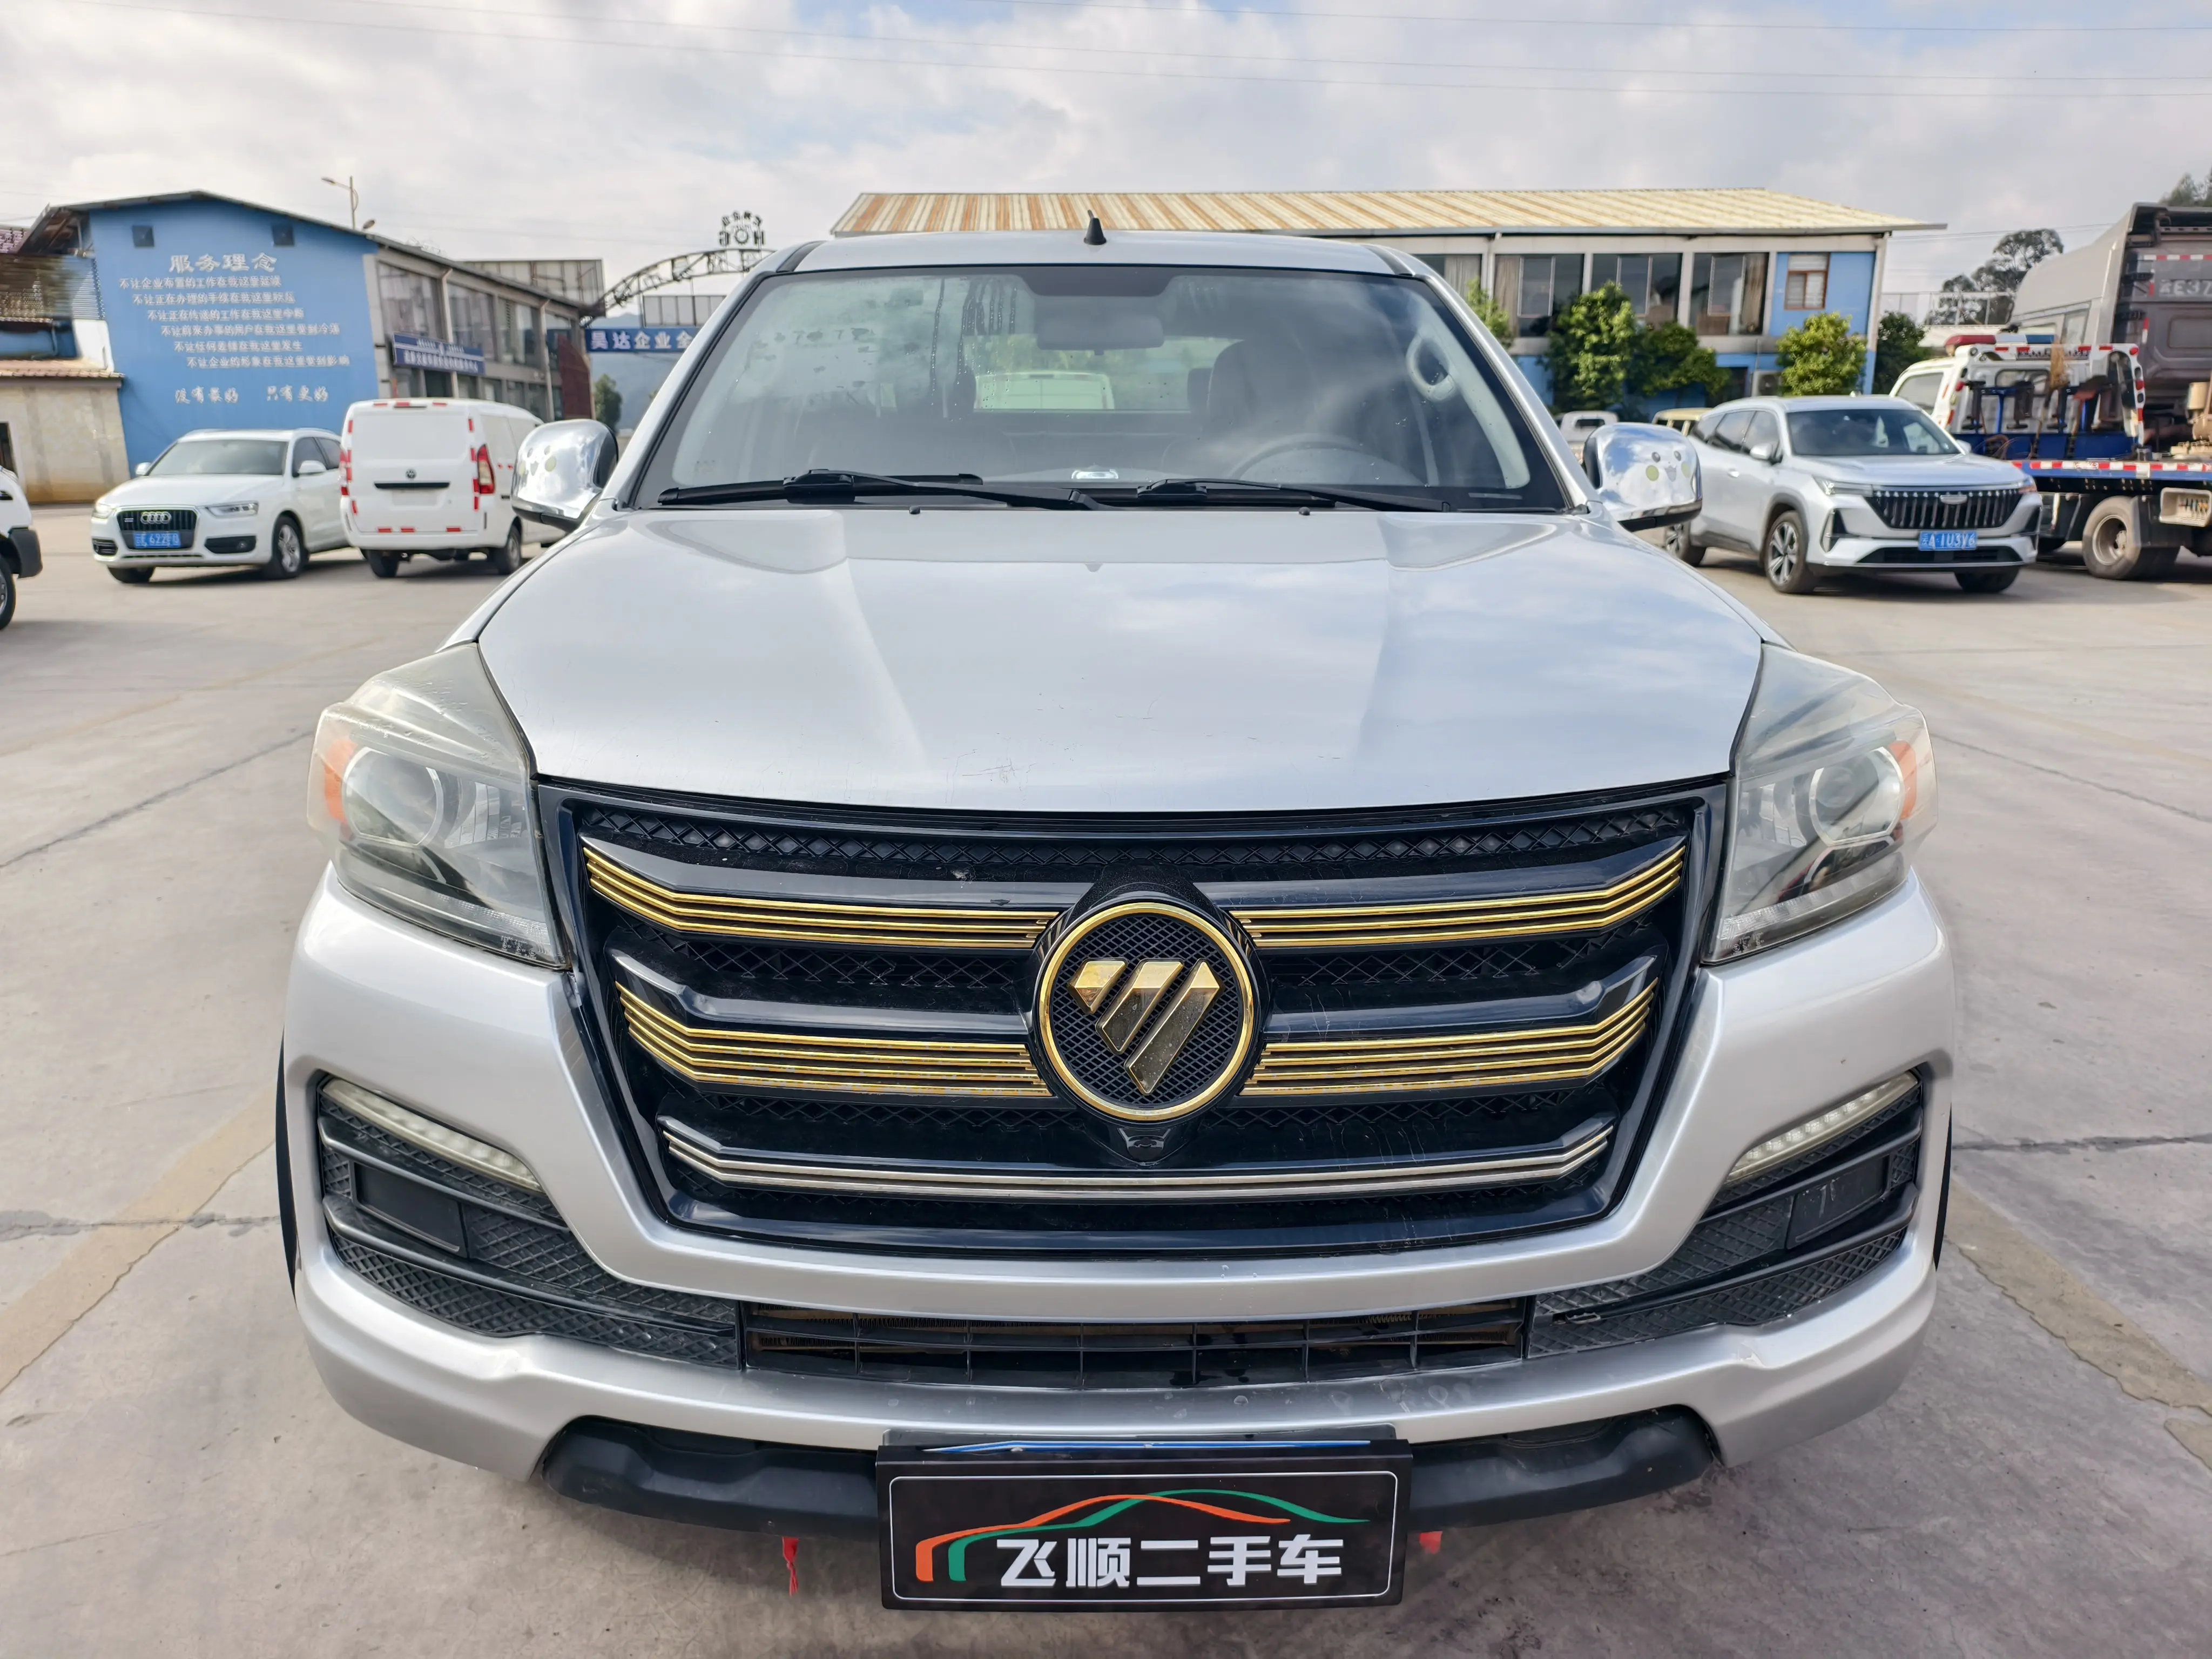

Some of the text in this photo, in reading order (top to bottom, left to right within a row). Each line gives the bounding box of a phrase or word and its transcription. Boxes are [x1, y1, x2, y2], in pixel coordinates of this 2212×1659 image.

[168, 253, 278, 274] 服务理念
[174, 384, 329, 404] 没有最好 只有更好
[997, 1534, 1344, 1588] 飞顺二手车
